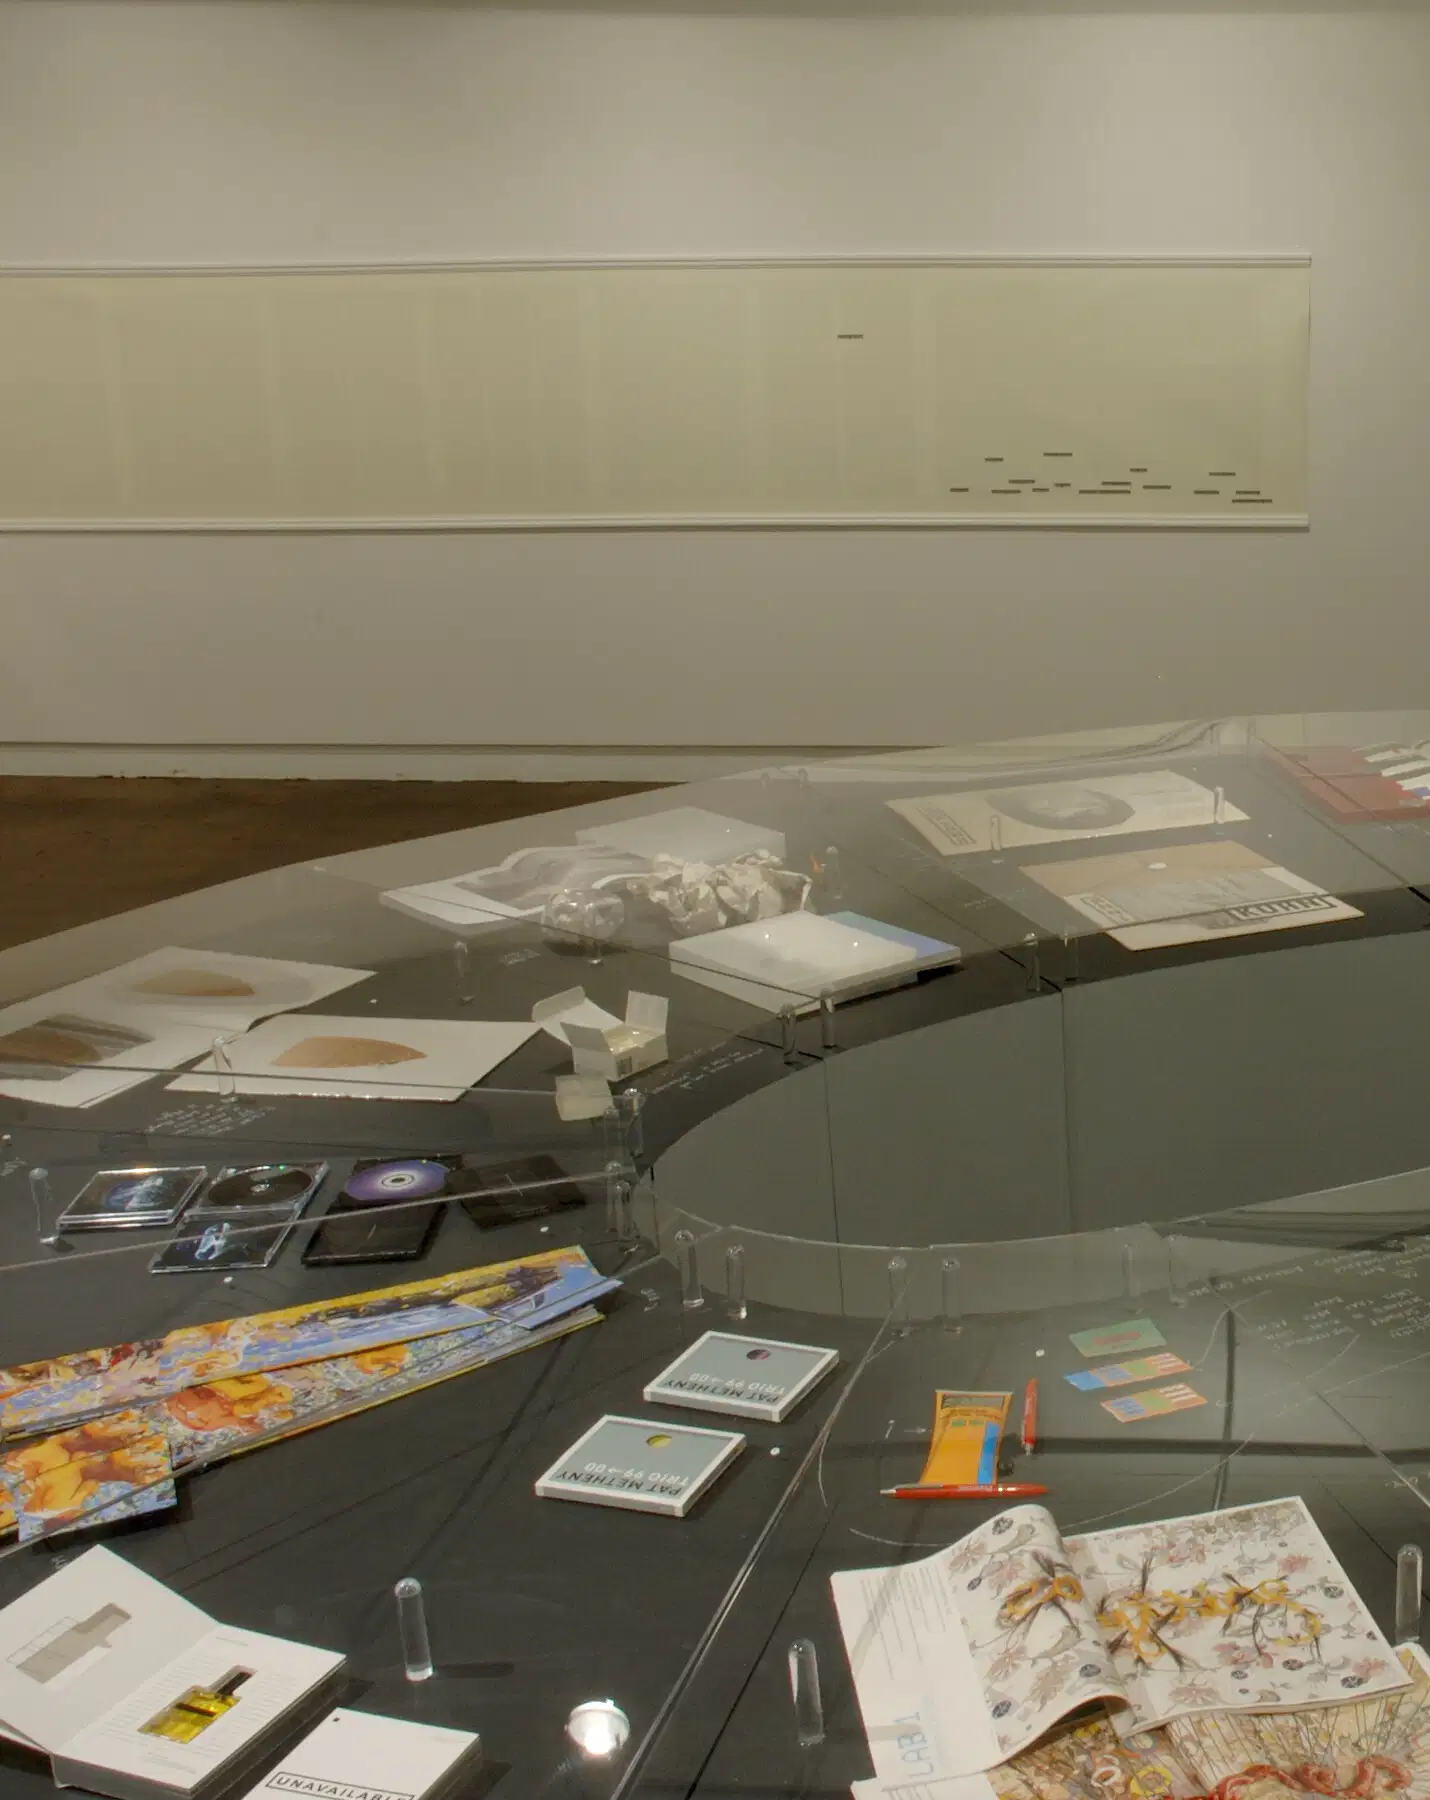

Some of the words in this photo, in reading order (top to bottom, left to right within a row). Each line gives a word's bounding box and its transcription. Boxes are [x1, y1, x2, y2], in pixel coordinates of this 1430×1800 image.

[663, 1380, 744, 1397] METHENY
[748, 1382, 787, 1395] TRIO
[746, 1392, 780, 1403] PAT
[556, 1470, 644, 1490] METHENY
[648, 1472, 689, 1486] TRIO
[646, 1484, 683, 1496] PAT
[896, 1732, 935, 1777] LAB
